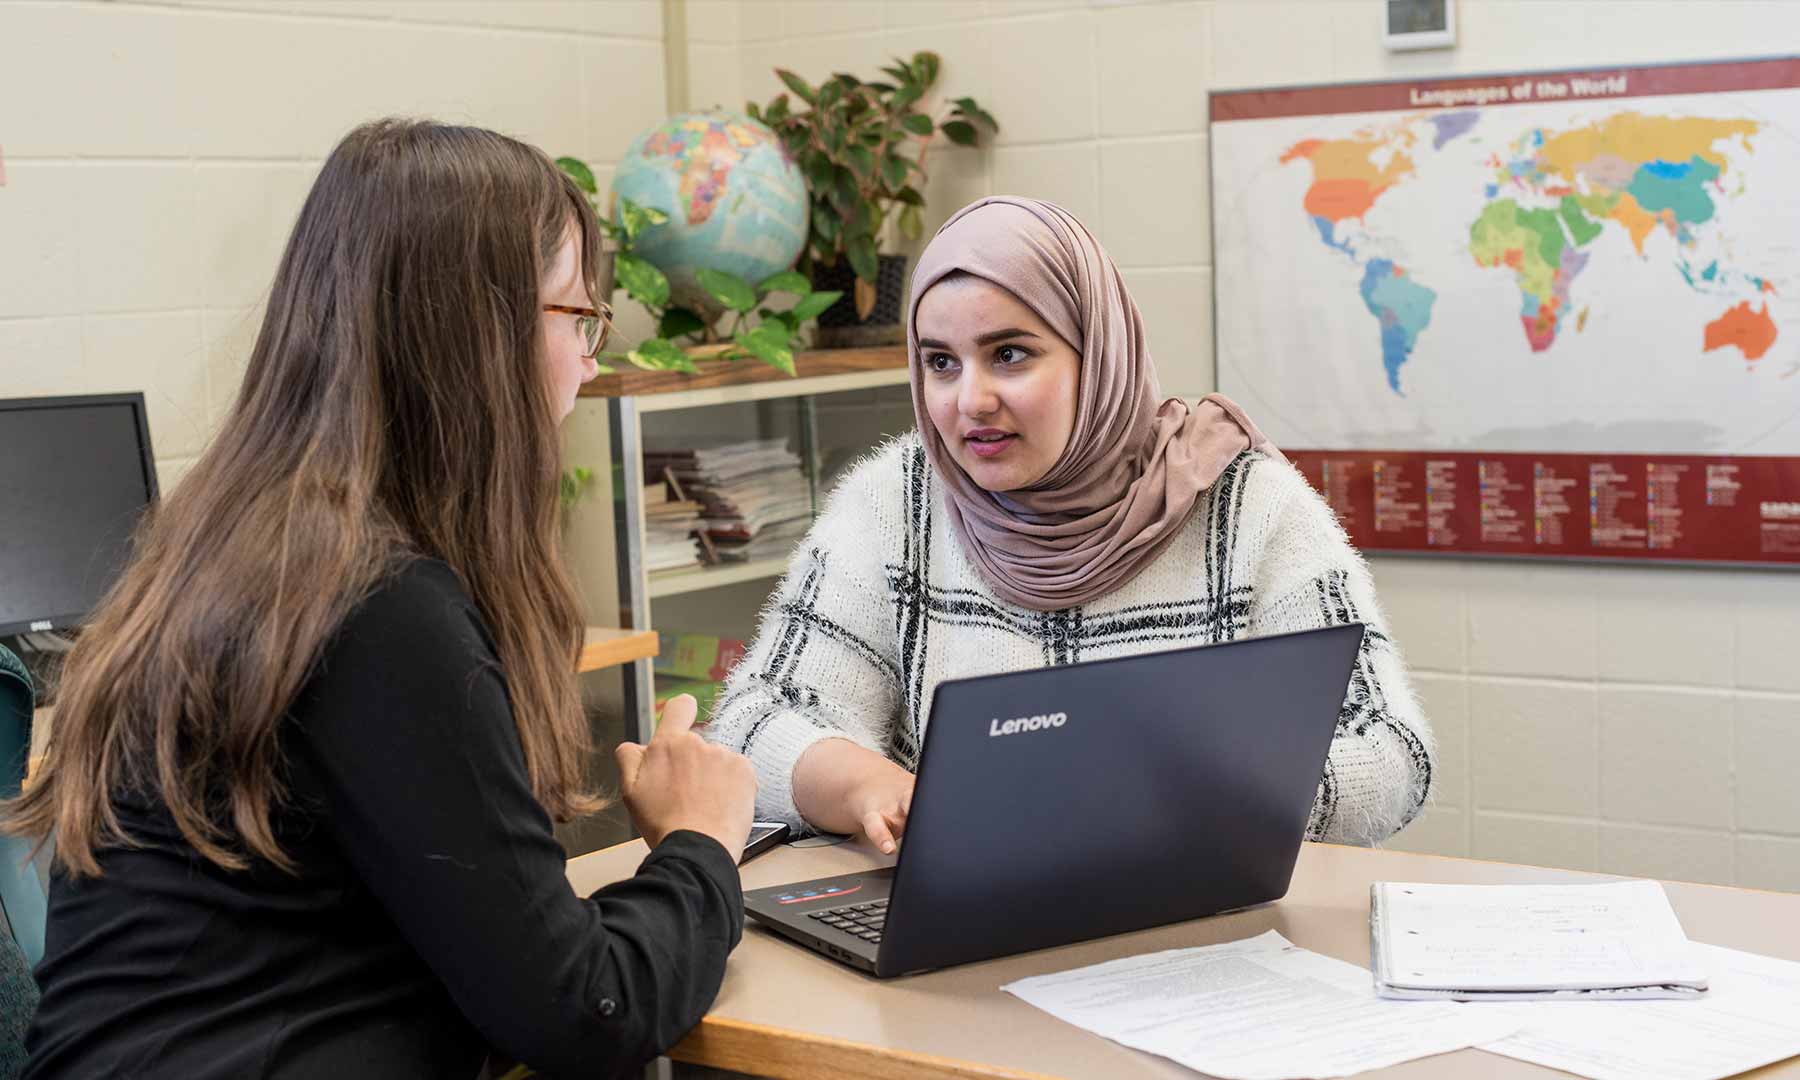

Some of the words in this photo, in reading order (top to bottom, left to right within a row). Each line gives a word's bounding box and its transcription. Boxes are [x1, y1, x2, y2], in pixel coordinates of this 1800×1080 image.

[1410, 86, 1509, 105] Languages
[1511, 81, 1532, 99] of
[1536, 80, 1568, 97] the
[1570, 76, 1628, 96] World
[989, 711, 1067, 737] Lenovo
